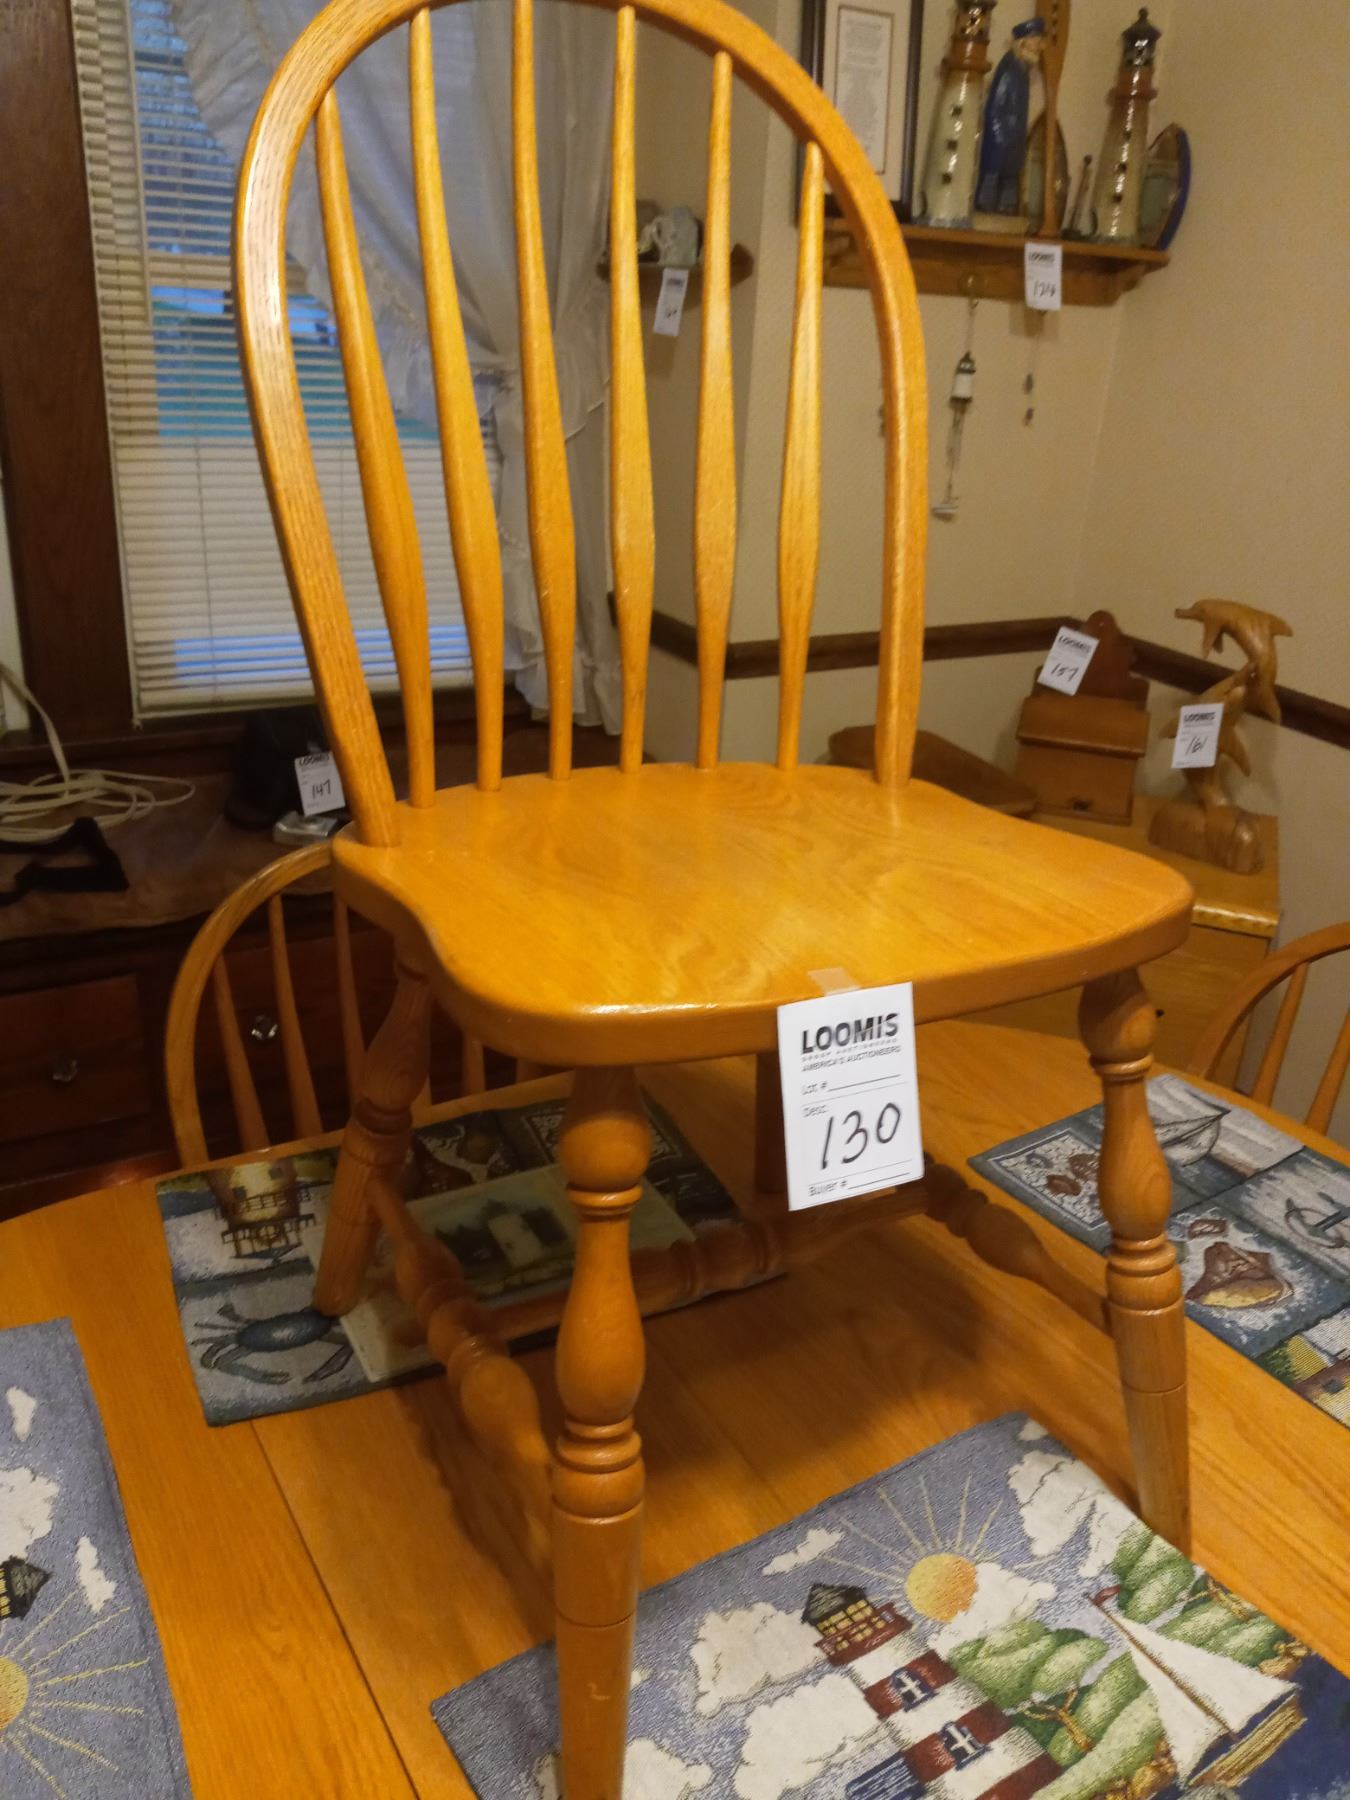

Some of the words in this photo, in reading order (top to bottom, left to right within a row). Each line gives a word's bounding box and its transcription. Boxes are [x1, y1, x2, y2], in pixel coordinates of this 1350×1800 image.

[1050, 662, 1079, 682] 157
[312, 778, 332, 799] 147
[801, 1012, 900, 1055] LOOMIS
[820, 1102, 901, 1170] 130
